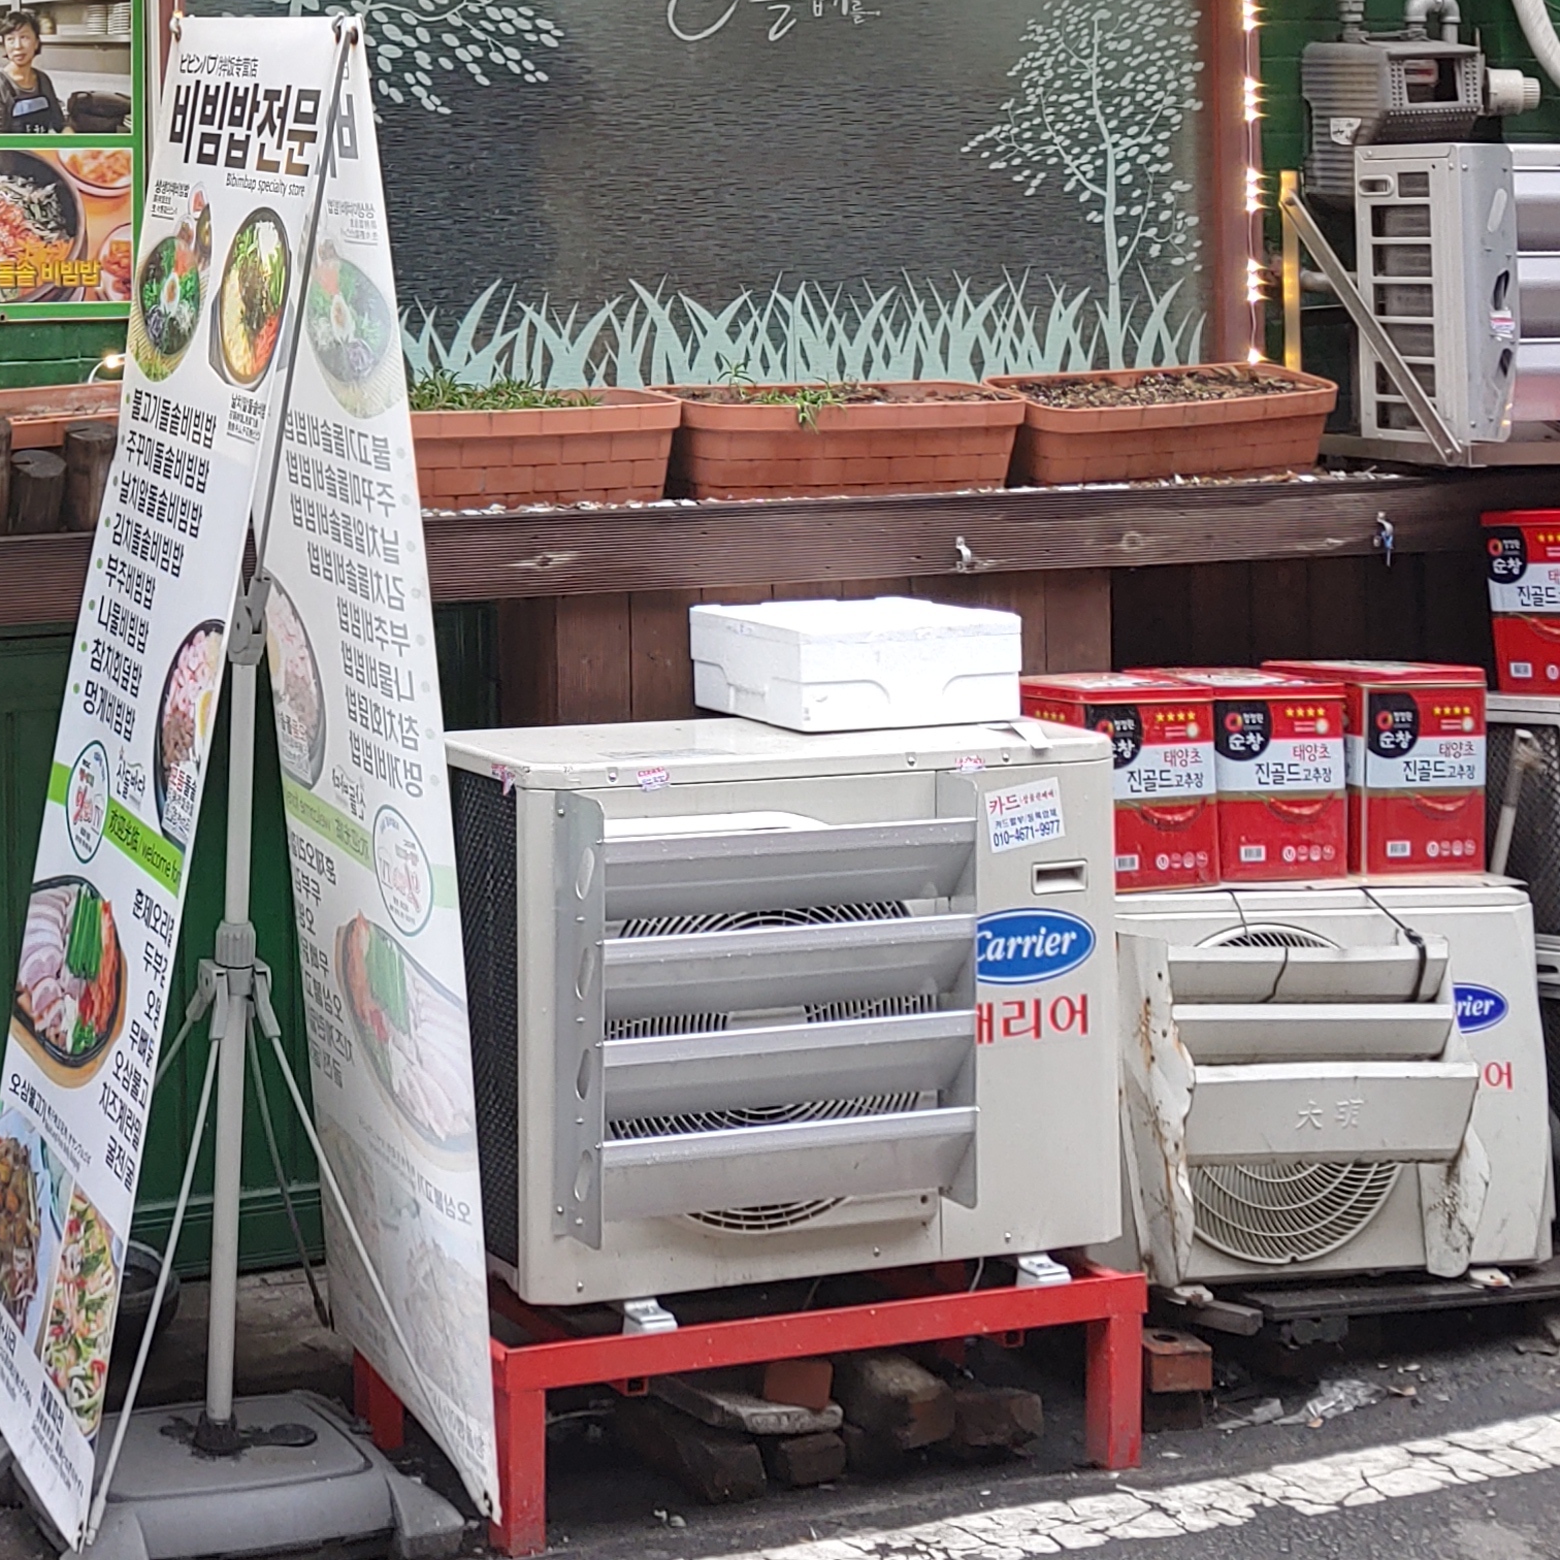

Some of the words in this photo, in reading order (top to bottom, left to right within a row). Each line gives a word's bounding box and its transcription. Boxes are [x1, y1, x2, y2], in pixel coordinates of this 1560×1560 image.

[226, 173, 257, 192] Bibimbap
[257, 177, 288, 197] specialty
[288, 183, 306, 198] store
[40, 260, 102, 288] 비빔밥
[132, 388, 217, 449] 불고기돌솥비빔밥
[126, 430, 210, 494] 주꾸미돌솥비빔밥
[119, 470, 203, 539] 날치알돌솥비빔밥
[112, 512, 185, 578] 김치돌솥비빔밥
[1492, 556, 1523, 576] 순창
[105, 554, 156, 611] 부추비빔밥
[97, 595, 149, 655] 나물비빔밥
[90, 638, 143, 698] 참치회덮밥
[83, 679, 137, 743] 멍게비빔밥
[1228, 732, 1266, 752] 순창
[1292, 743, 1332, 762] 태양초
[1378, 730, 1414, 749] 순창
[1439, 741, 1477, 759] 태양초
[1163, 749, 1203, 768] 태양초
[116, 759, 146, 800] 산들바다
[988, 793, 1021, 816] 카드
[992, 819, 1061, 848] 010-4671-9977
[1484, 1061, 1514, 1091] 어
[9, 1073, 48, 1123] 오삼불고기
